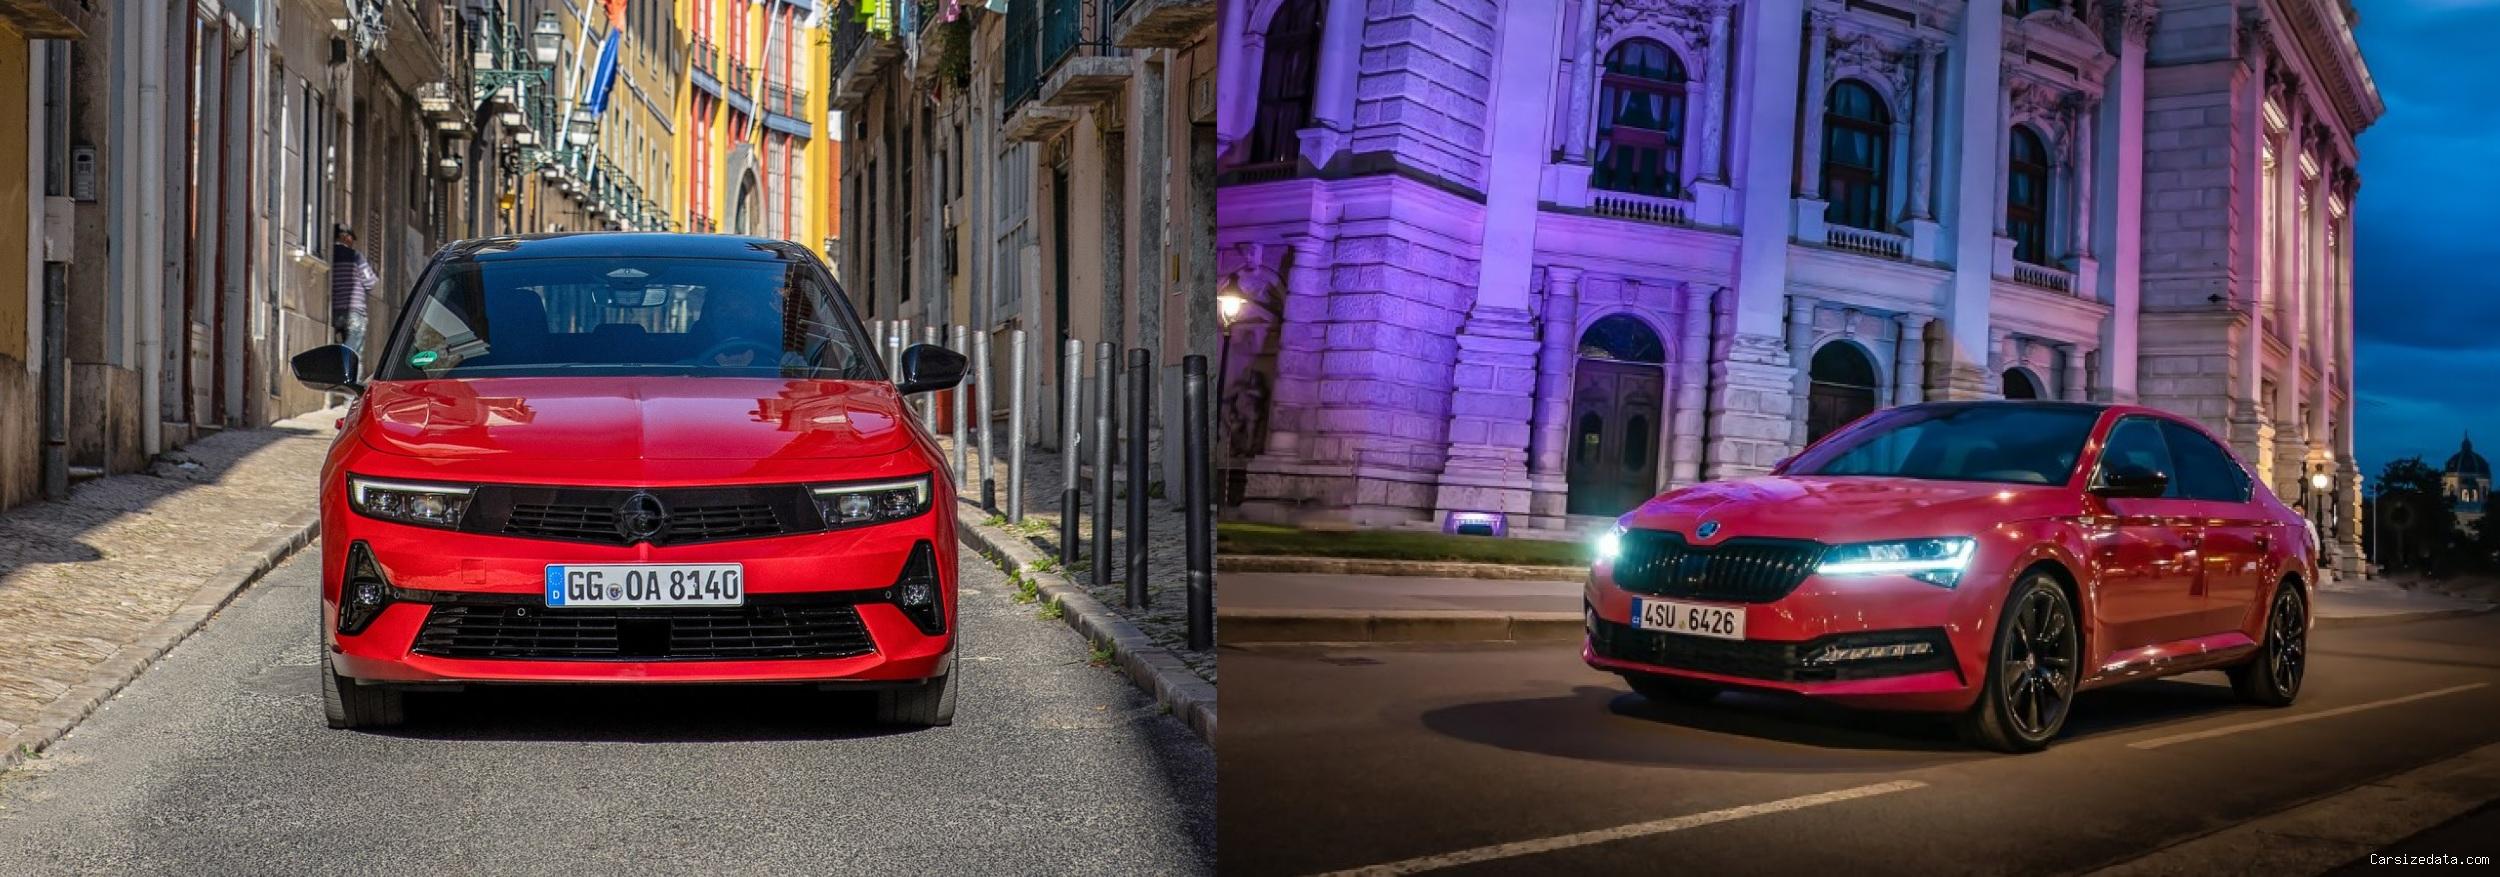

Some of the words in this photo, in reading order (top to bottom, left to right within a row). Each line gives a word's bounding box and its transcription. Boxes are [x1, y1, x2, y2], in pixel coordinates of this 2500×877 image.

[553, 590, 560, 600] D
[567, 571, 603, 600] GG
[626, 570, 661, 600] OA
[670, 570, 738, 600] 8140
[1645, 603, 1676, 628] 4SU
[1688, 608, 1735, 635] 6426
